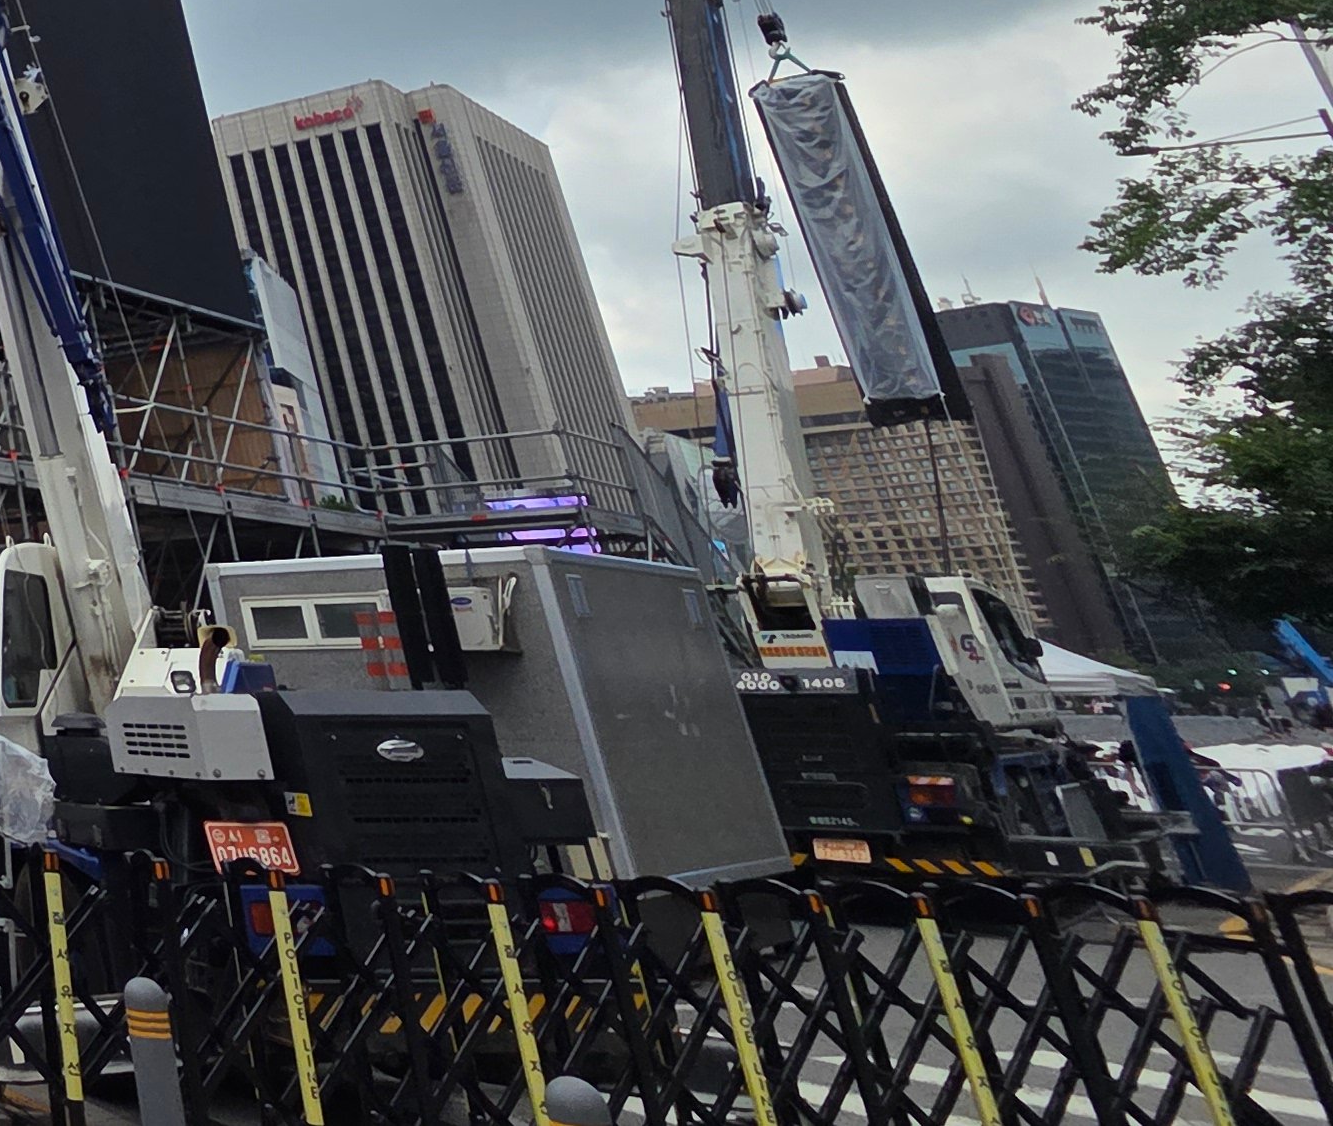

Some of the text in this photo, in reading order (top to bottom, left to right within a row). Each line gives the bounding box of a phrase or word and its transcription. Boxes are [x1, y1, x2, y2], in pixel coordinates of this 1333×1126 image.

[735, 680, 781, 691] 4000
[740, 672, 772, 682] 010
[284, 932, 307, 1022] POLICE
[724, 953, 755, 1045] POLICE
